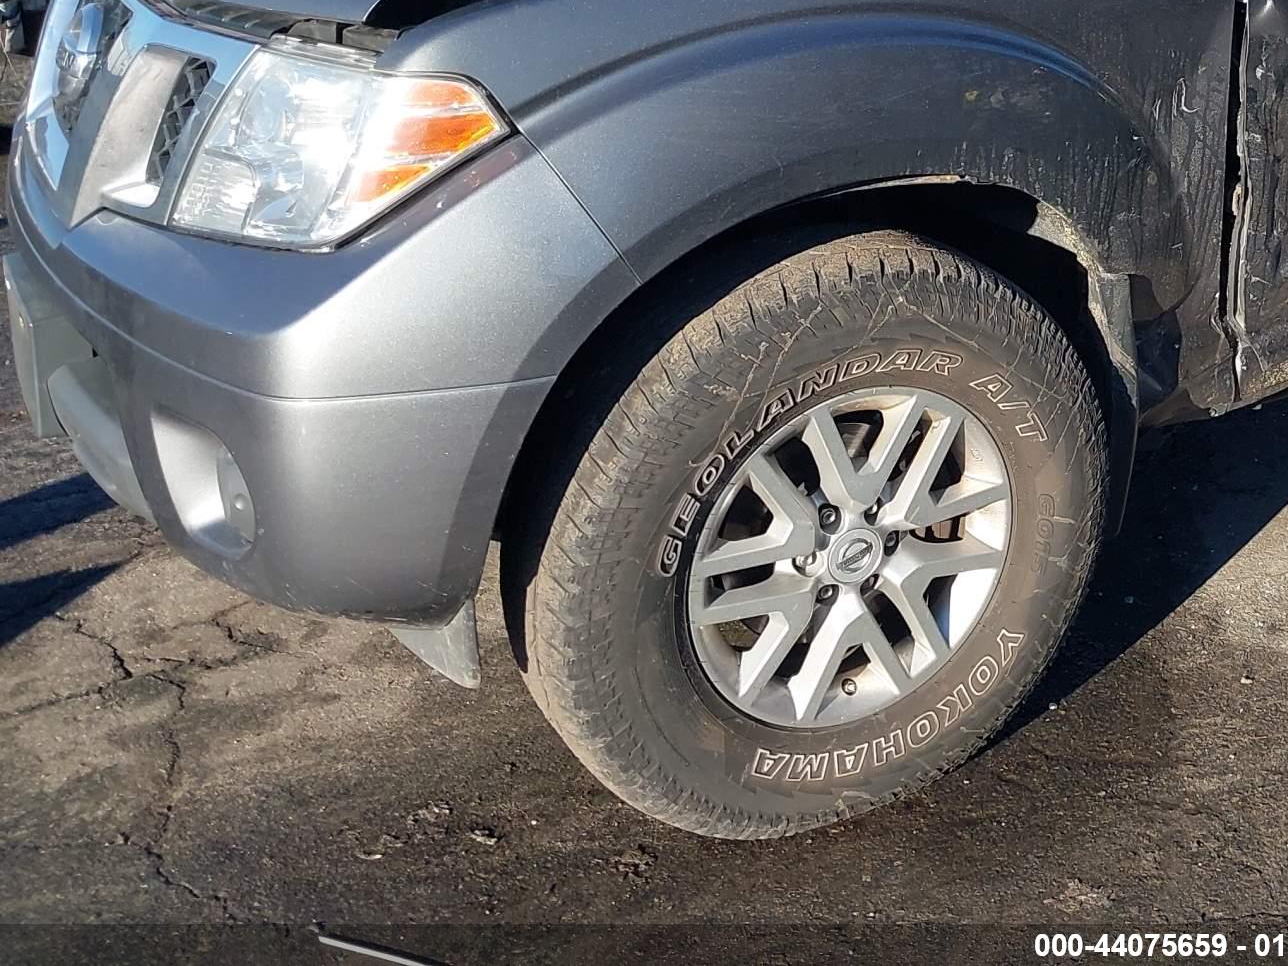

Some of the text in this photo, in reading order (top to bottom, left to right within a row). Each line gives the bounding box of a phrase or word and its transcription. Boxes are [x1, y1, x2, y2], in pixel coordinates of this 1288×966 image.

[658, 348, 1047, 578] GEOLANDAR A/T
[751, 628, 1025, 782] YOKOHAMA
